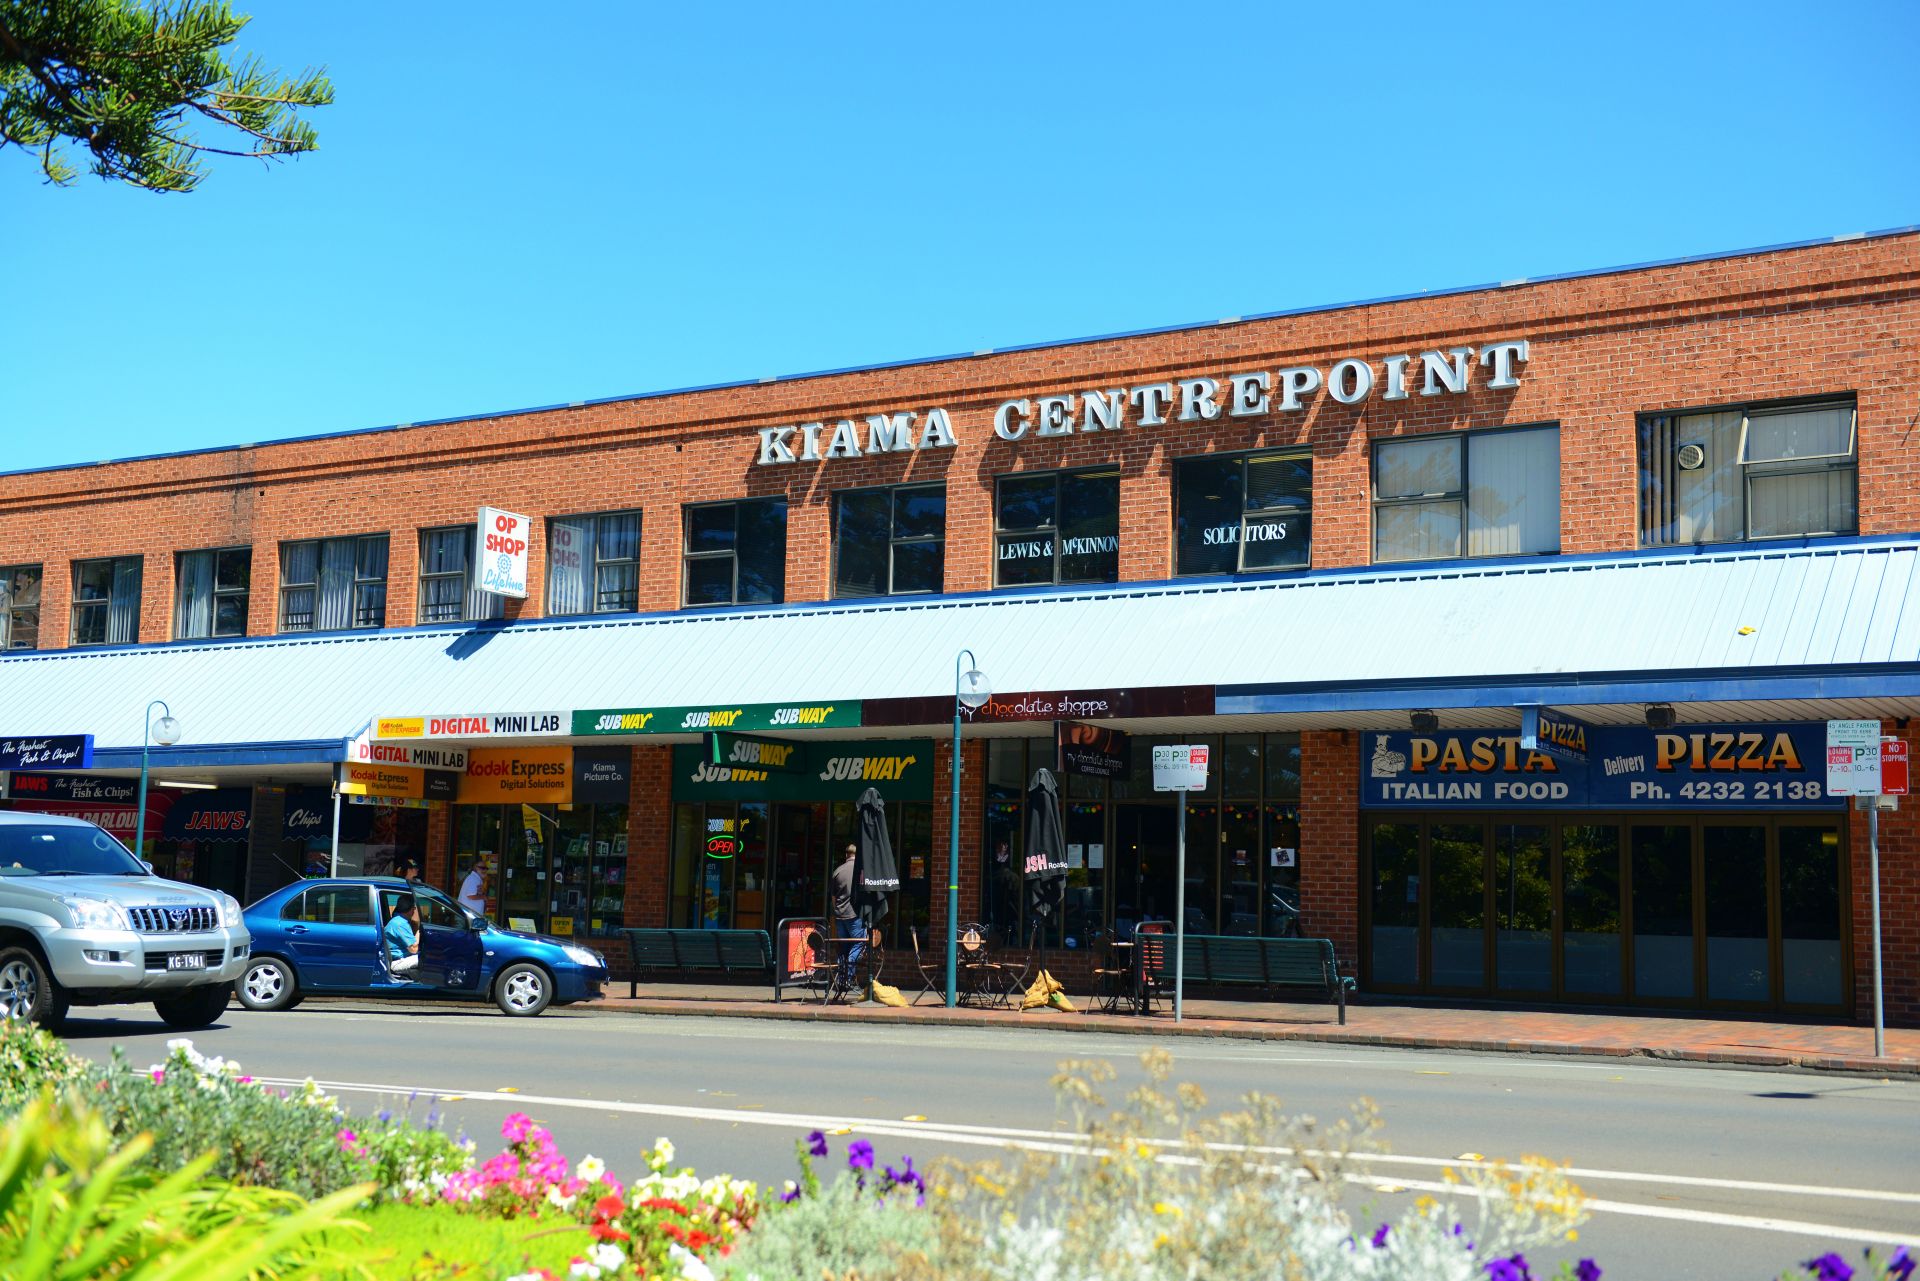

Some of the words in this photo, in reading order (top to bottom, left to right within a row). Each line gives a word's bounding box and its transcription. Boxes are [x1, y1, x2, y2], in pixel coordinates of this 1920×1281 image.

[757, 407, 956, 467] KIAMA
[993, 339, 1530, 442] CENTREPOINT
[496, 515, 517, 534] OP
[1203, 523, 1286, 545] SOLICITORS
[486, 534, 525, 556] SHOP
[1000, 541, 1041, 560] LEWIS
[1043, 539, 1053, 557] &
[484, 569, 524, 591] Lifeline
[981, 694, 1053, 716] chocolate
[1058, 696, 1109, 716] shoppe
[430, 718, 490, 735] DIGITAL
[494, 717, 527, 733] MINI
[531, 715, 560, 731] LAB
[595, 712, 654, 731] SUBWAY
[681, 709, 743, 728] SUBWAY
[770, 706, 834, 725] SUBWAY
[1539, 717, 1587, 752] PIZZA
[2, 741, 16, 754] The
[18, 740, 52, 754] Freshest
[20, 753, 39, 766] Fish
[41, 750, 51, 761] &
[52, 746, 80, 763] Chips!
[360, 744, 409, 762] DIGITAL
[413, 749, 439, 766] MINI
[442, 752, 464, 767] LAB
[729, 740, 793, 766] SUBWAY
[1410, 736, 1558, 772] PASTA
[1655, 732, 1802, 771] PIZZA
[1889, 744, 1899, 753] NO
[593, 762, 616, 771] Kiama
[819, 754, 916, 781] SUBWAY
[1604, 754, 1645, 776] Delivery
[1882, 754, 1907, 762] STOPPING
[351, 768, 377, 780] Kodak
[378, 771, 409, 783] Express
[466, 759, 509, 776] Kodak
[511, 759, 565, 779] Express
[584, 773, 609, 782] Picture
[611, 772, 624, 781] Co.
[55, 778, 67, 788] The
[72, 787, 92, 798] Fish
[94, 788, 102, 797] &
[104, 786, 134, 799] Chips!
[500, 779, 527, 791] Digital
[528, 778, 565, 789] Solutions
[1382, 783, 1481, 800] ITALIAN
[1495, 782, 1569, 800] FOOD
[1630, 781, 1671, 799] Ph.
[1680, 781, 1745, 799] 4232
[1754, 781, 1822, 799] 2138
[185, 811, 247, 830] JAWS
[288, 809, 323, 828] Chips
